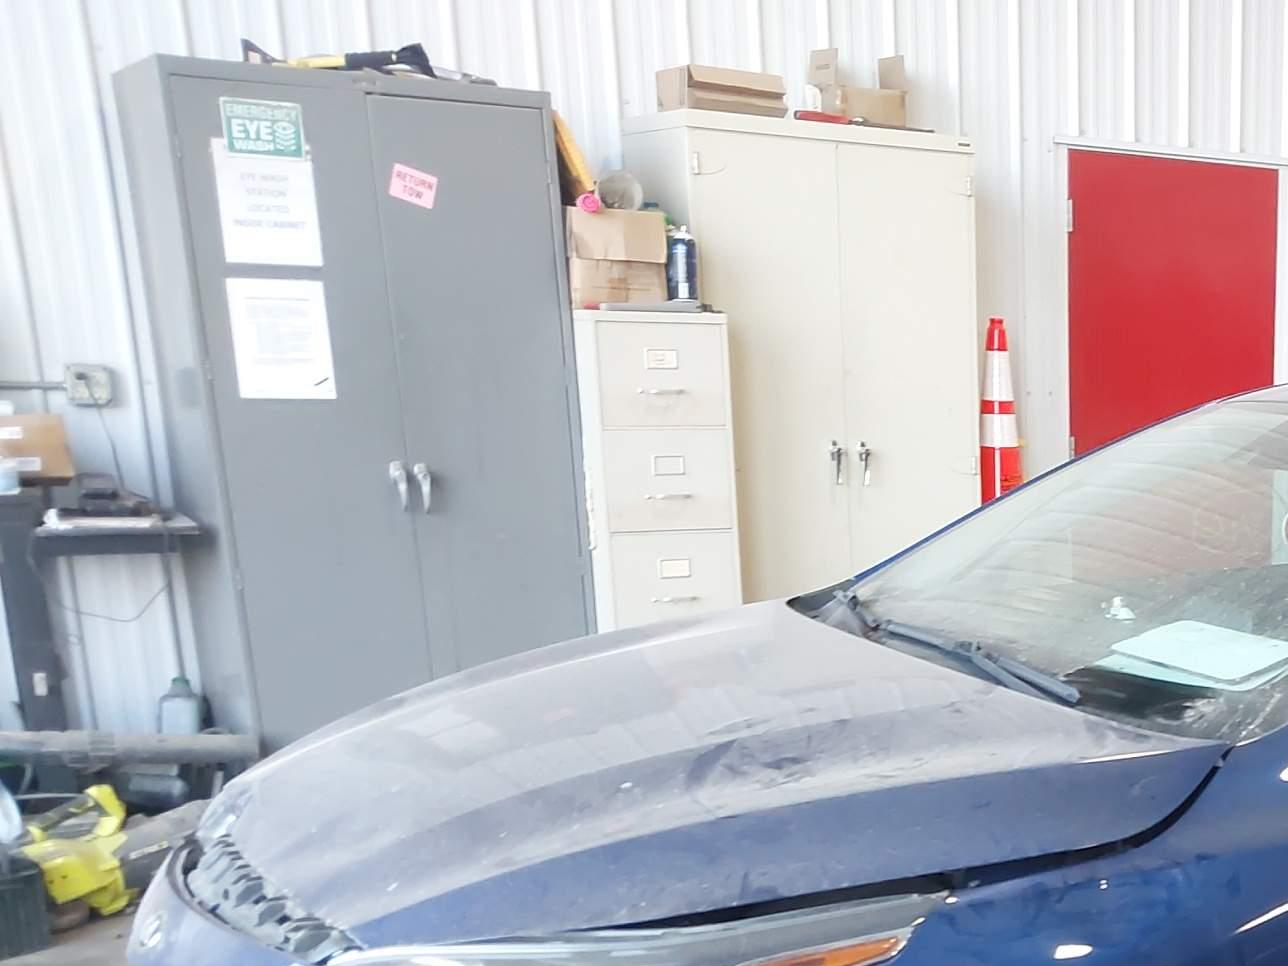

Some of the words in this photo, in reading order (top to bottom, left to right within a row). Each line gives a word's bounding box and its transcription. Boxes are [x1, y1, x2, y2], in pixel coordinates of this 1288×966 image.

[224, 103, 298, 121] EMERGENCY
[230, 118, 274, 141] EYE
[232, 139, 275, 152] WASH
[395, 170, 434, 192] RETURN
[402, 184, 424, 200] TOW
